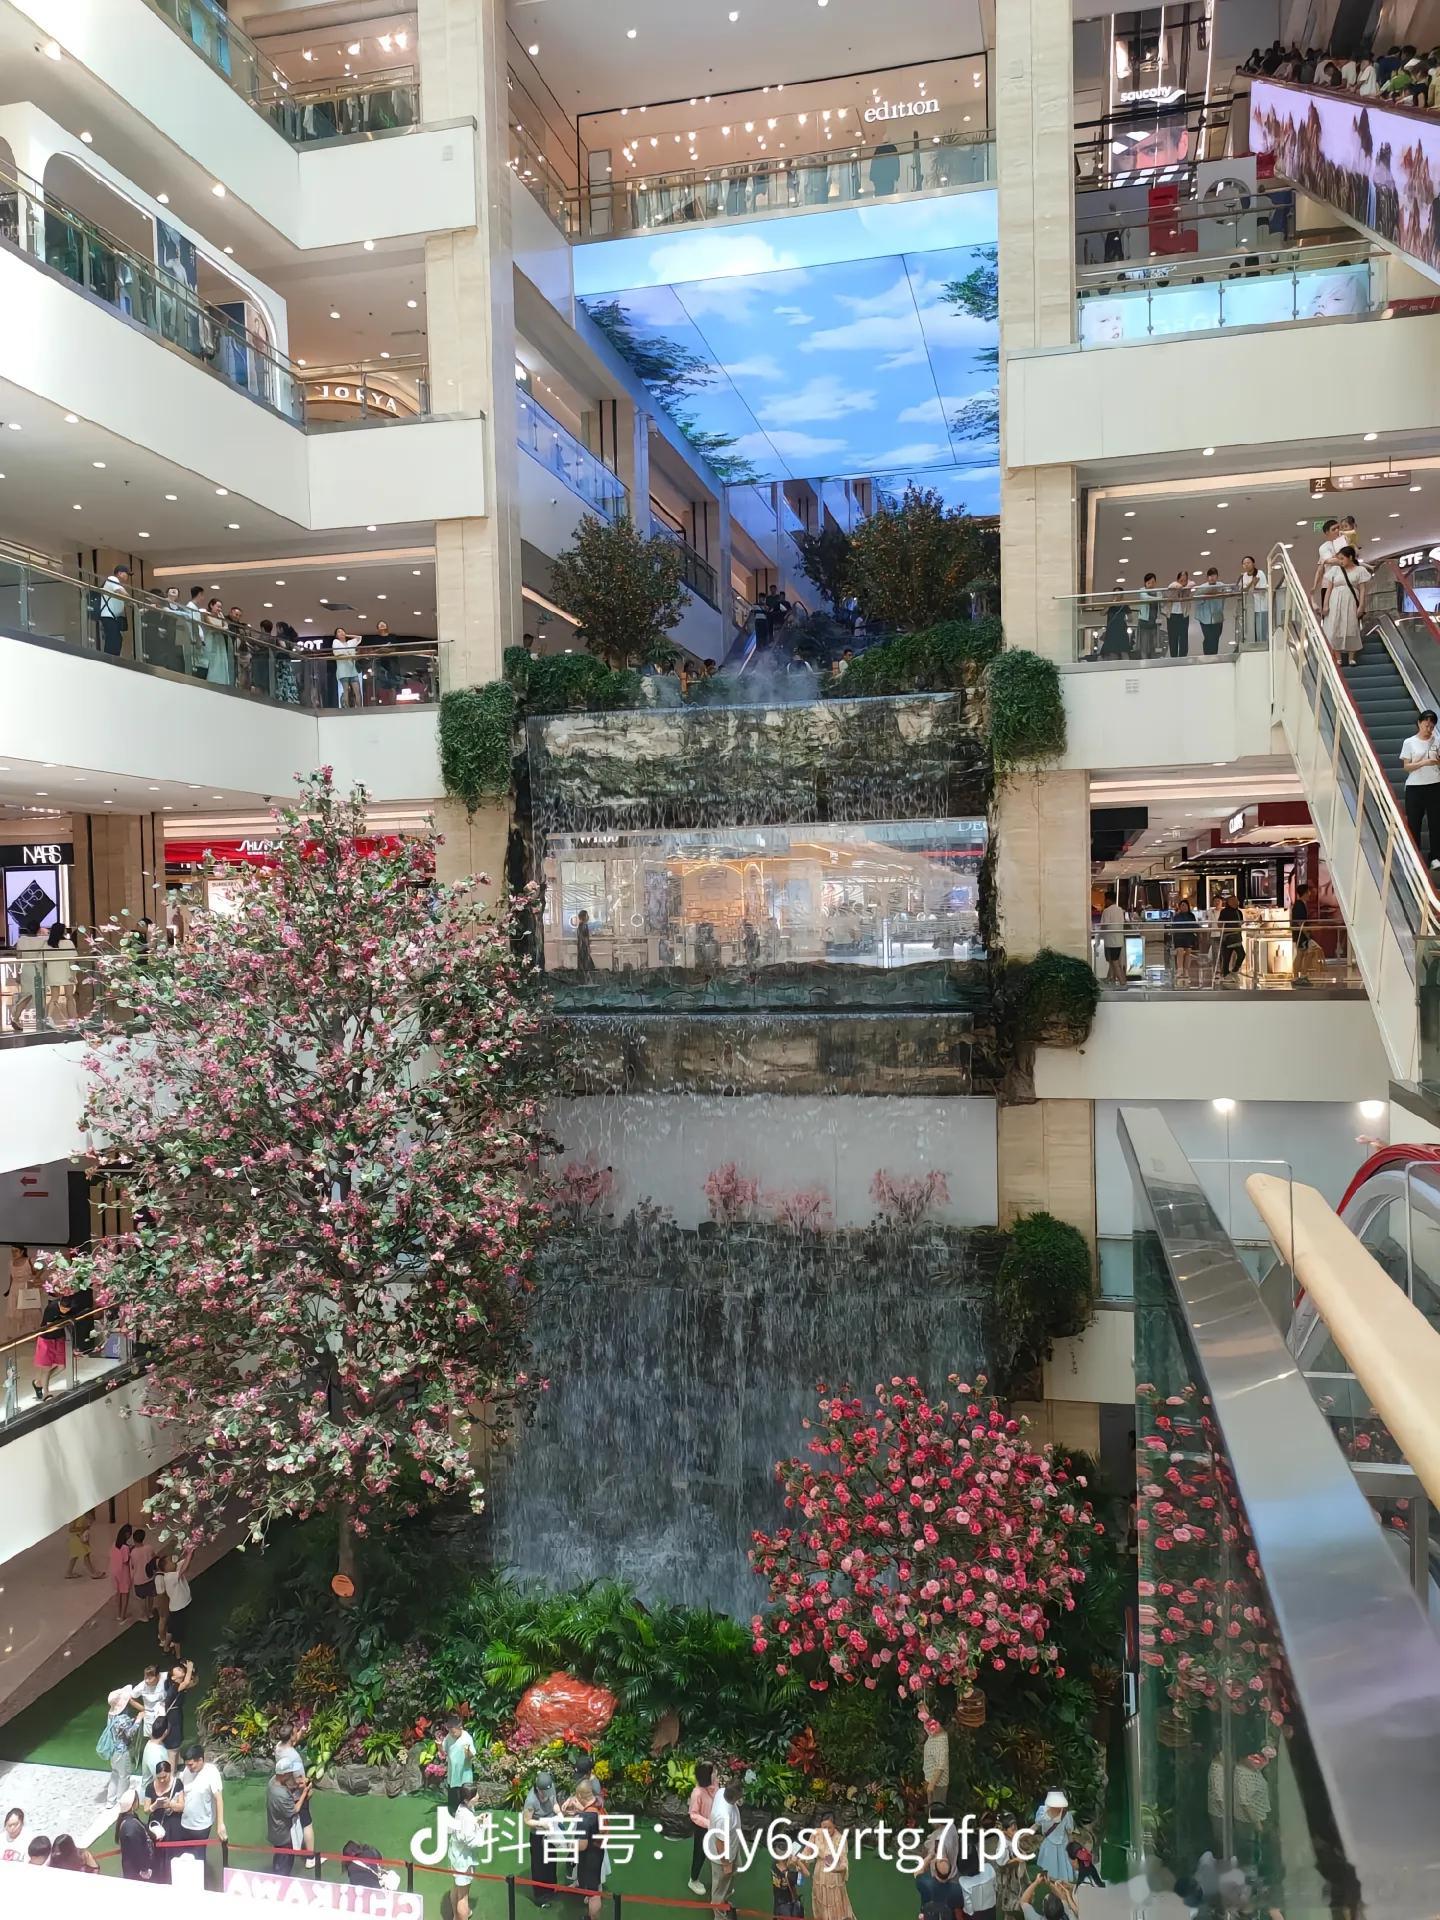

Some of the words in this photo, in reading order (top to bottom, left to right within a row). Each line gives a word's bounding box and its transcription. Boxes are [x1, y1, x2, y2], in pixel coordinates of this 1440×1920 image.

[1120, 86, 1172, 102] saucony
[864, 99, 940, 123] edition
[1315, 479, 1327, 488] 2F
[23, 844, 62, 864] NARS
